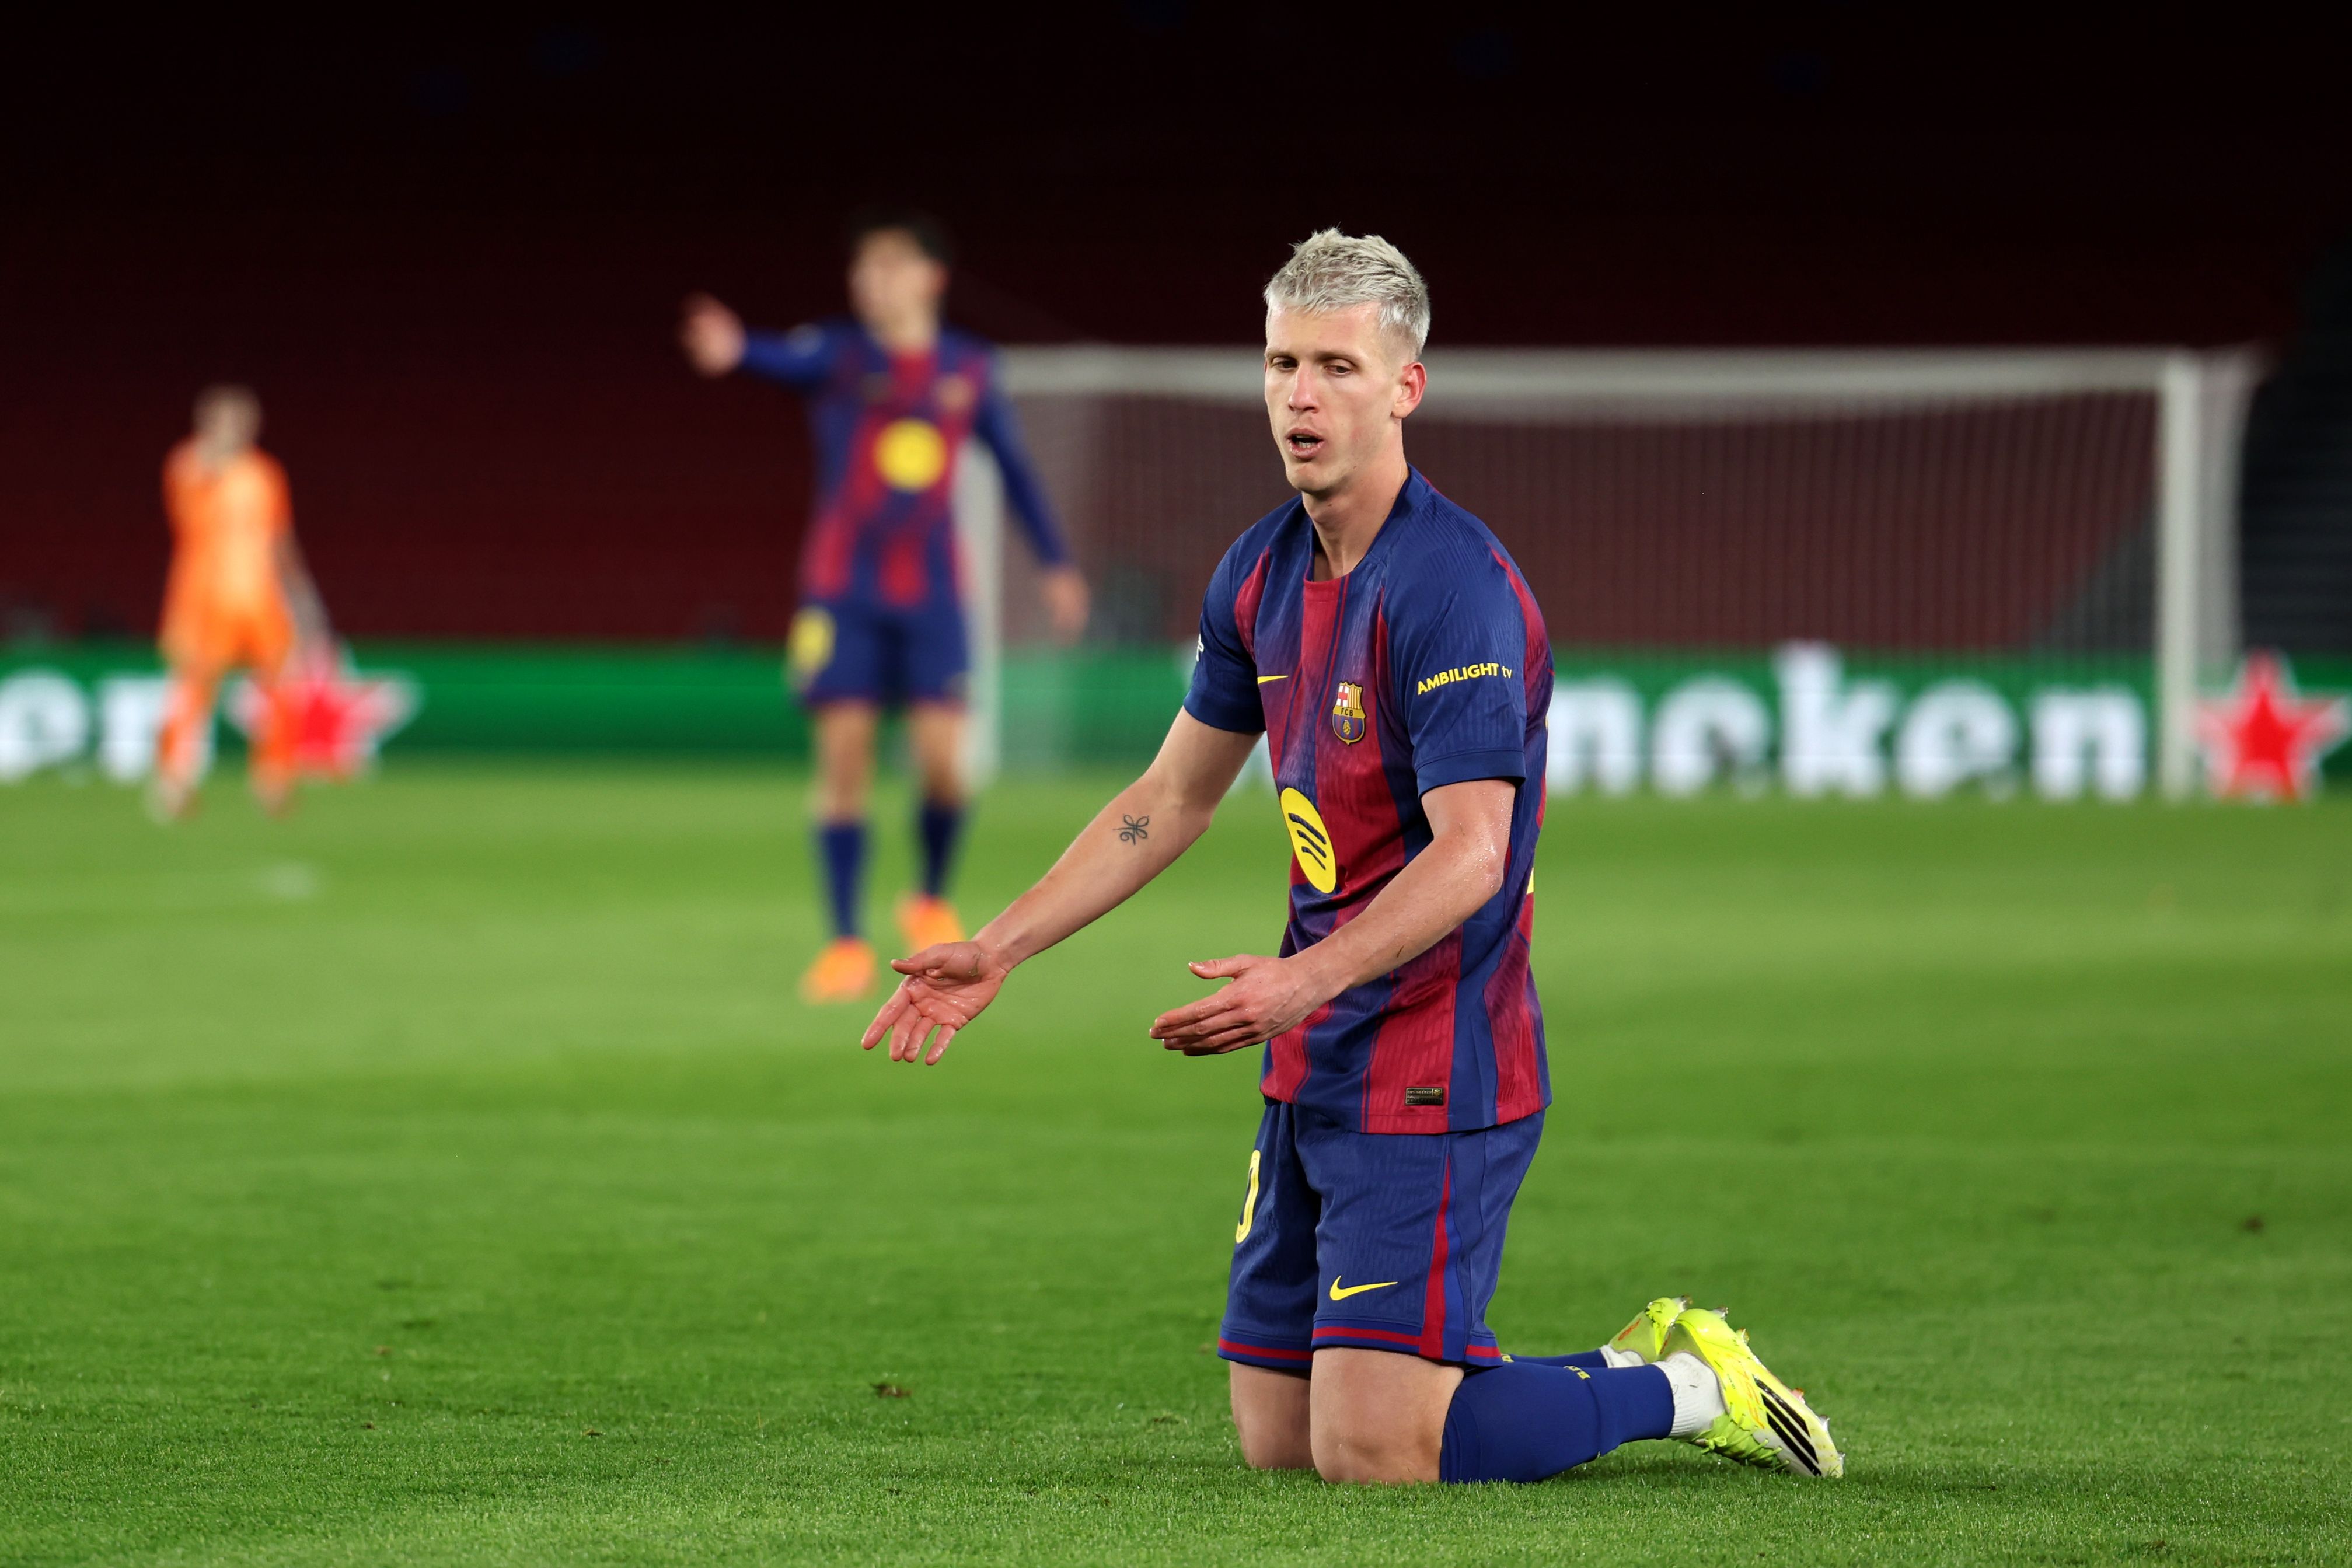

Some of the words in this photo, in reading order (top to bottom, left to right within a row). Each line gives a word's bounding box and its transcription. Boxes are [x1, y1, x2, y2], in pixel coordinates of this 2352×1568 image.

[1417, 663, 1499, 695] AMBILIGHT
[1501, 665, 1513, 679] tv
[1341, 708, 1353, 717] FCB
